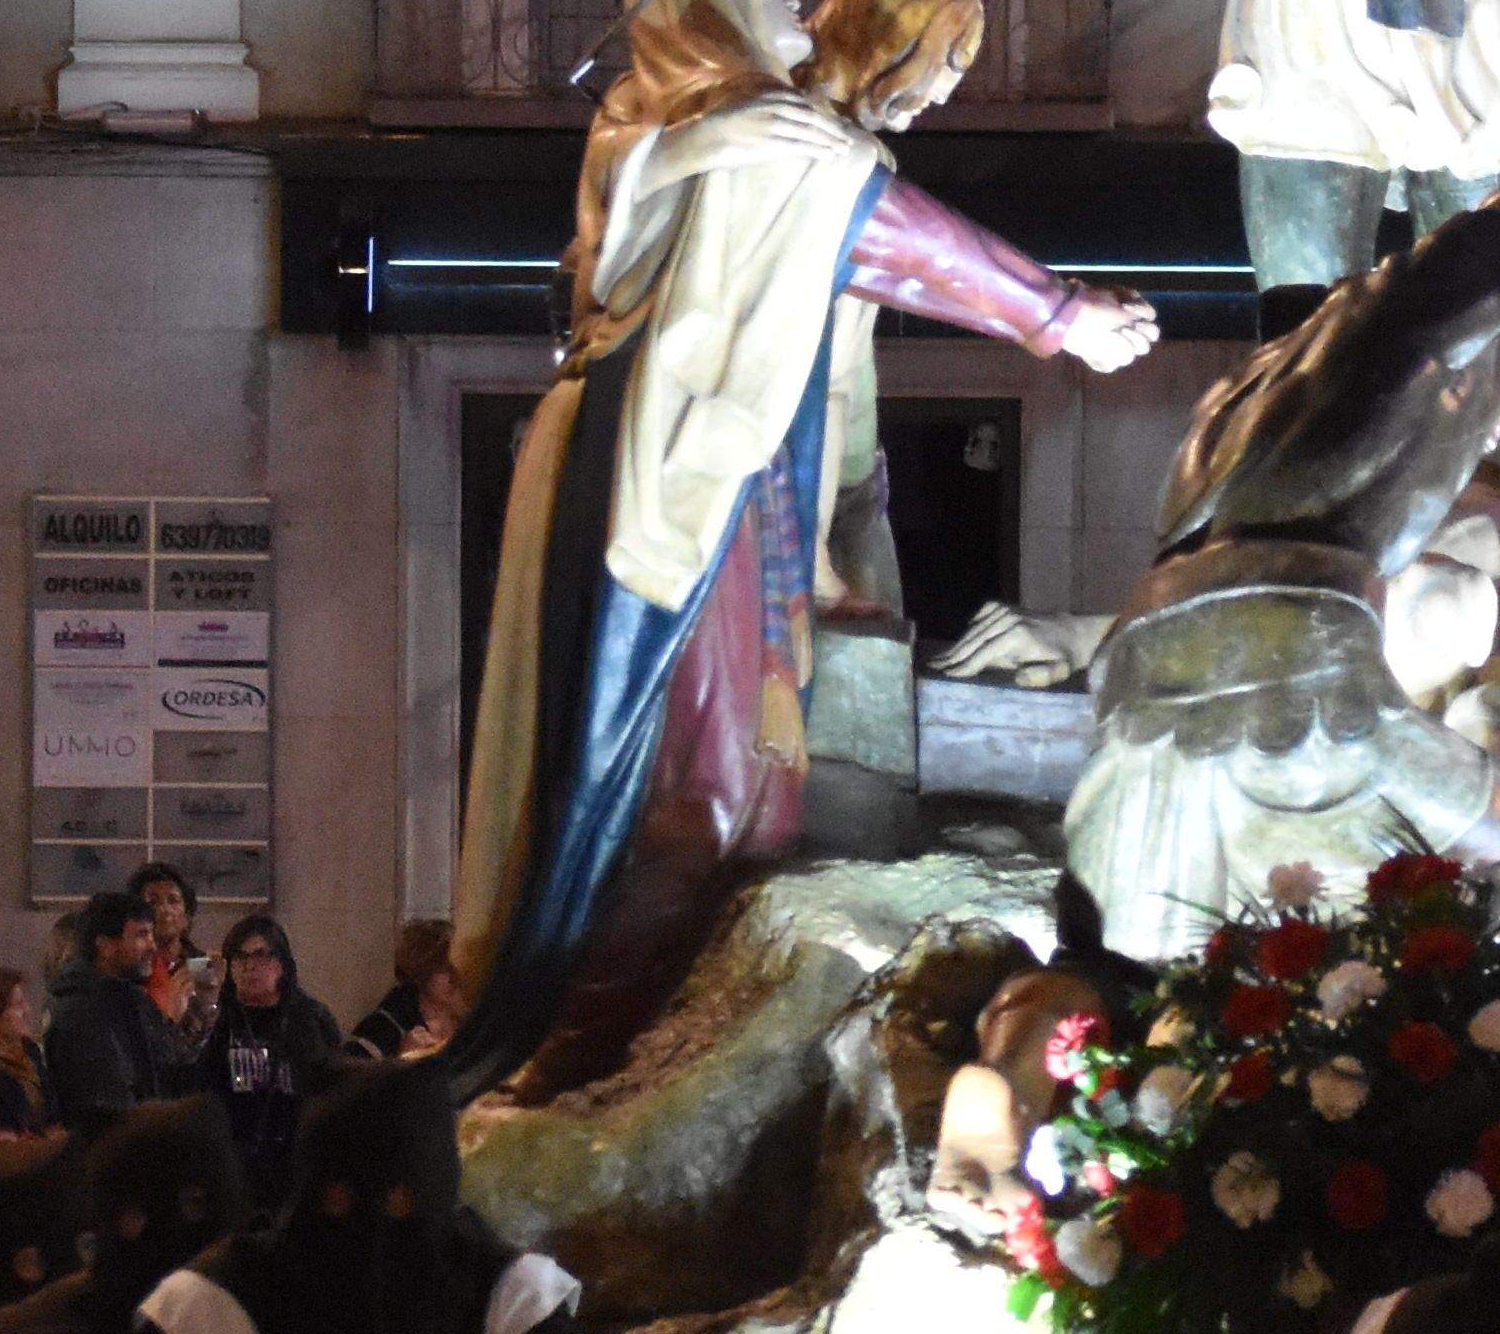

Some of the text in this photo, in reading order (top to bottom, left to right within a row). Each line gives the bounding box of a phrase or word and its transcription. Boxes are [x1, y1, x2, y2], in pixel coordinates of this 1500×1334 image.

[43, 513, 141, 544] ALQUILO
[43, 576, 142, 595] OFICINAS
[173, 690, 254, 707] ORDESA
